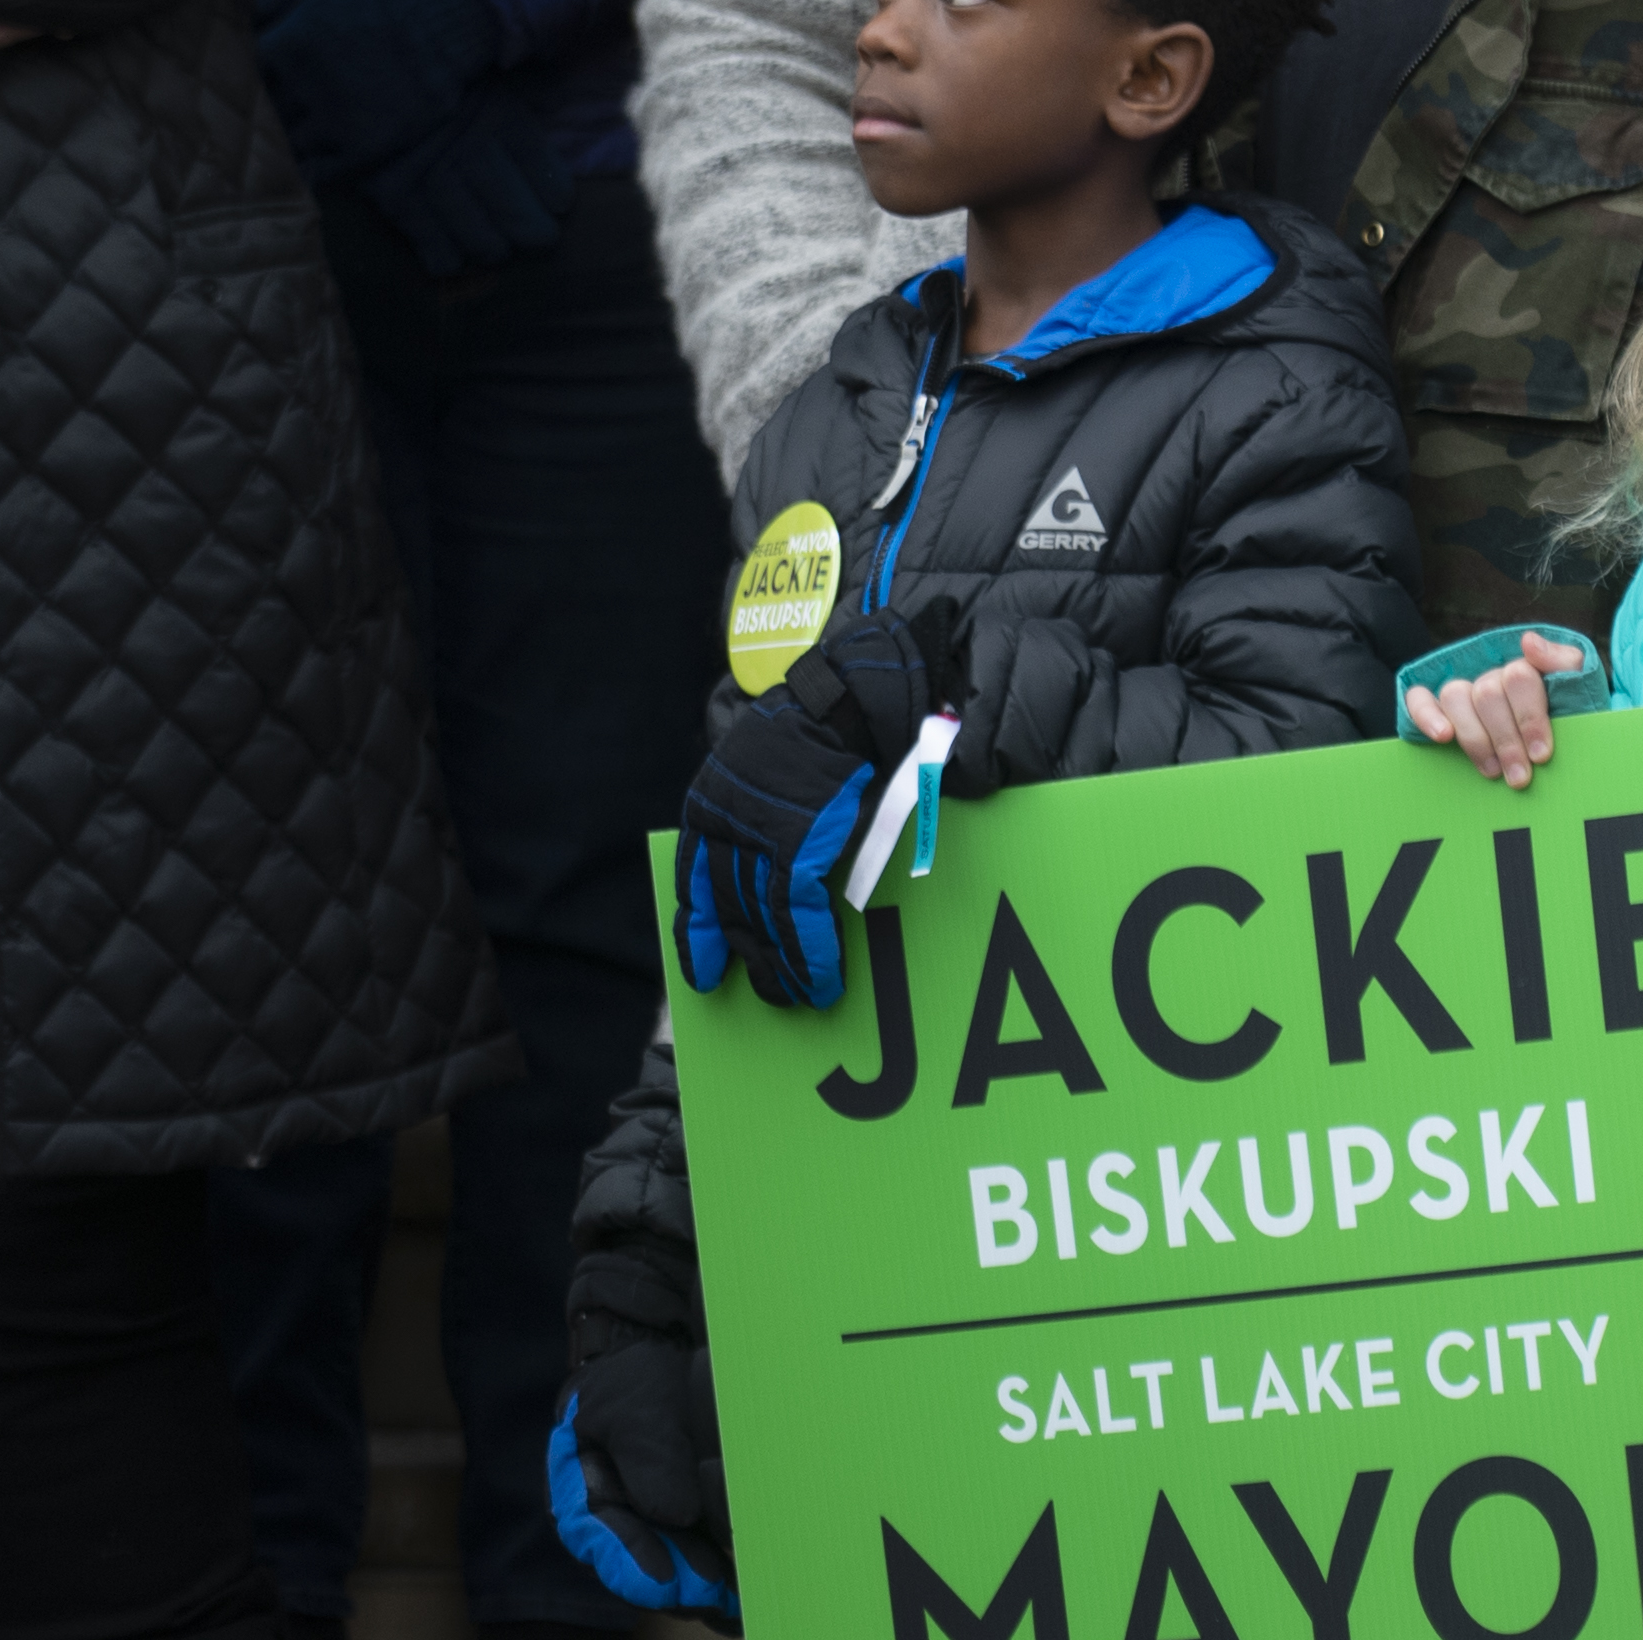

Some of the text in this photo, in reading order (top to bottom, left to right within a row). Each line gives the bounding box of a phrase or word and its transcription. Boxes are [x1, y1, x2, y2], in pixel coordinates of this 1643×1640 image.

[743, 555, 831, 598] JACKIE
[1018, 531, 1109, 552] GERRY
[733, 600, 822, 635] BISKUPSKI
[921, 772, 933, 860] SATURDAY
[968, 1099, 1596, 1269] BISKUPSKI
[996, 1314, 1610, 1444] SALT LAKE CITY
[879, 1443, 1643, 1640] MAYO
